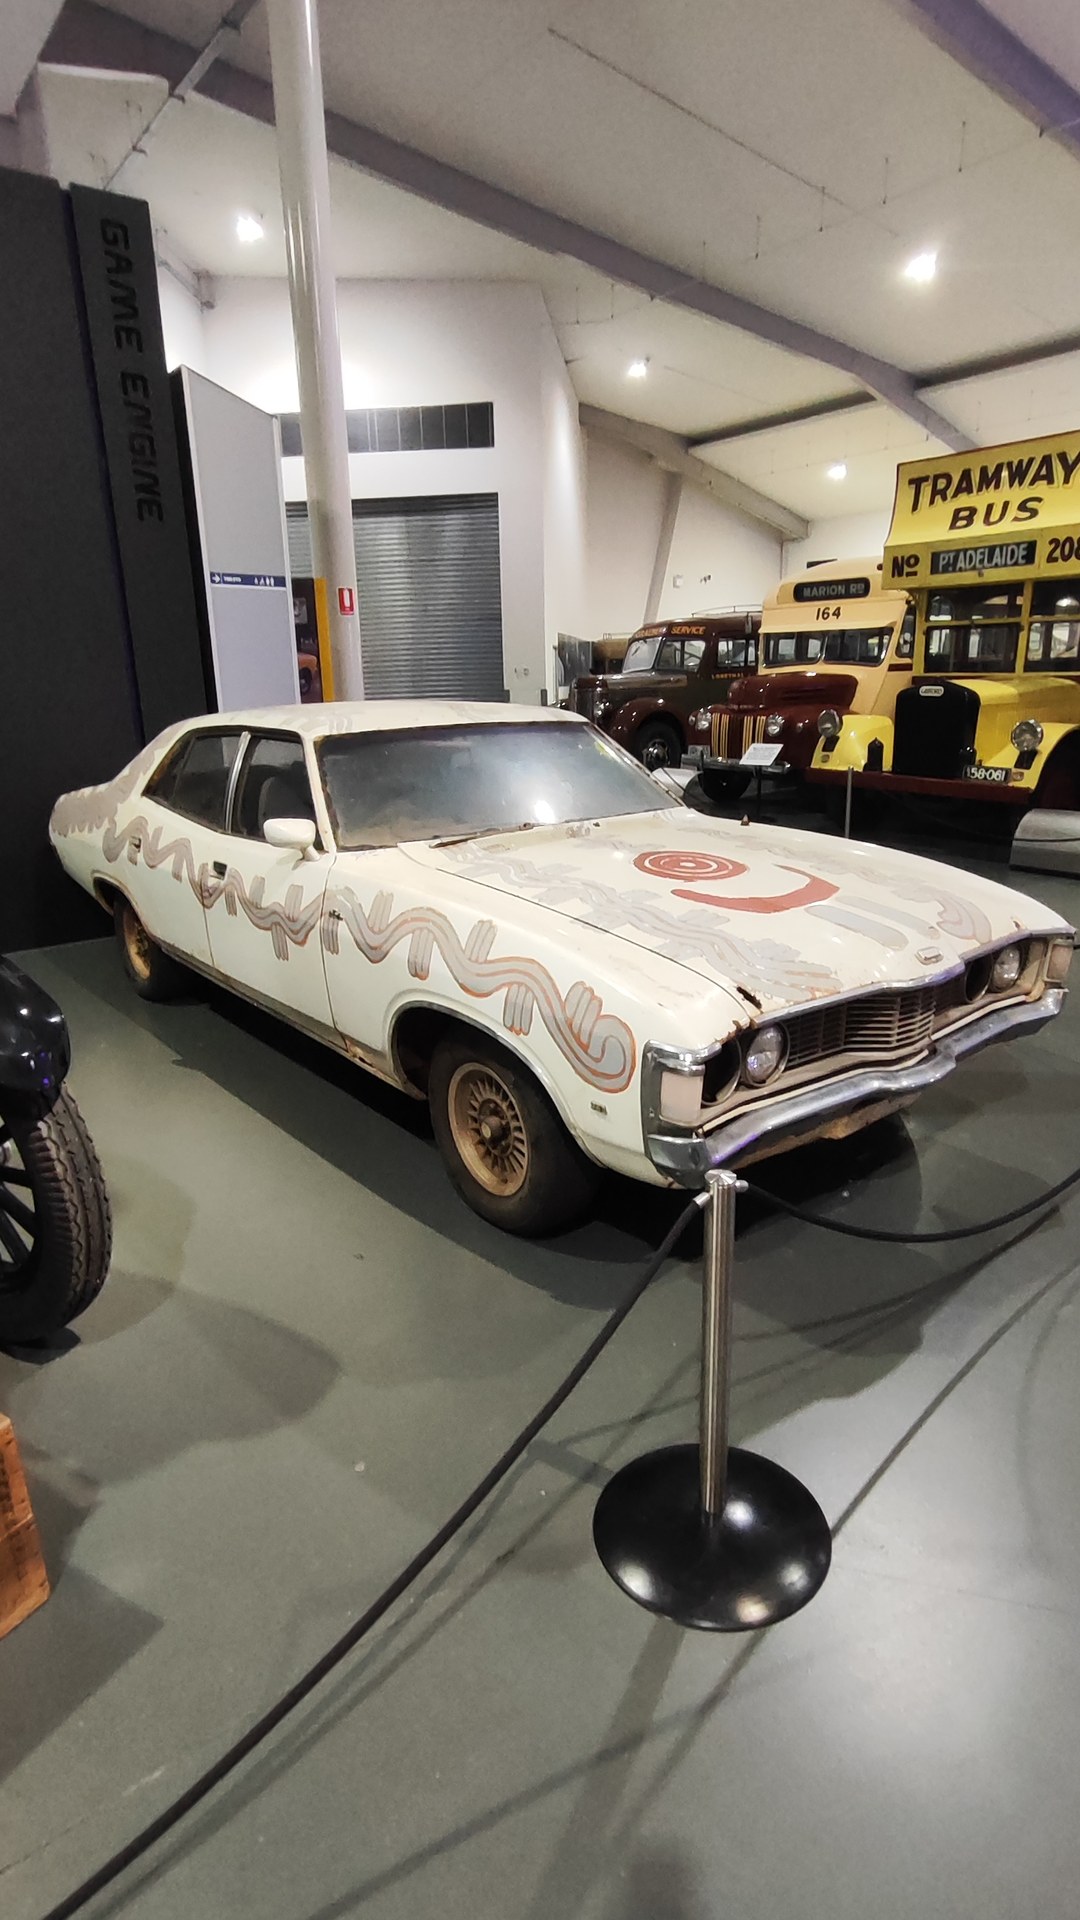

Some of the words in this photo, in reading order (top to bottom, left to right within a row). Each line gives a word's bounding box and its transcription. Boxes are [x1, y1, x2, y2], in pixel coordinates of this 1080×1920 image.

[101, 218, 143, 353] GAME
[120, 371, 164, 522] ENGINE
[908, 450, 1080, 514] TRAMWAY
[949, 496, 1044, 531] BUS
[955, 543, 1028, 571] ADELAIDE
[803, 584, 846, 598] MARION
[816, 606, 841, 620] 164
[671, 626, 706, 635] SERVICE
